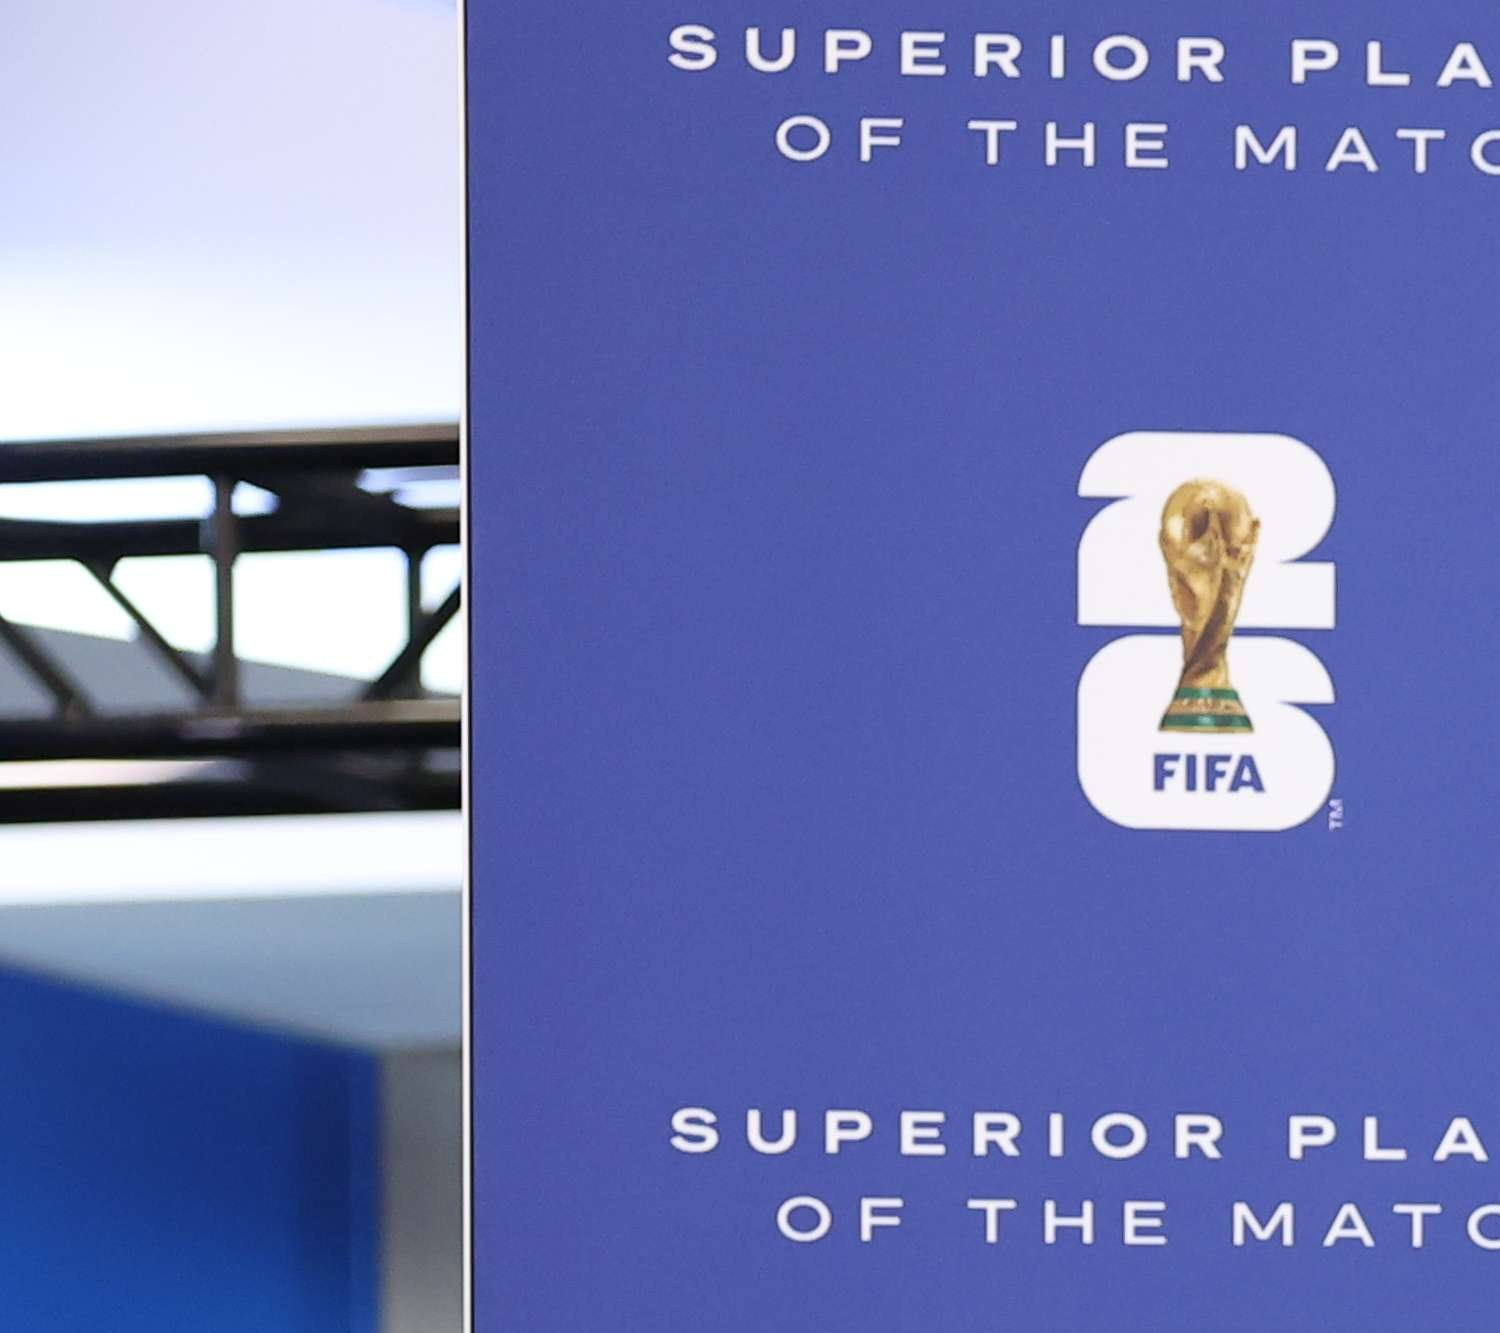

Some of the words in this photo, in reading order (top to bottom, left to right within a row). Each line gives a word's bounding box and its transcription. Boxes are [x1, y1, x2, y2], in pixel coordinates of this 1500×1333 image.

[667, 24, 1225, 82] SUPERIOR
[775, 115, 903, 162] OF
[967, 120, 1169, 168] THE
[1153, 752, 1266, 793] FIFA
[670, 1107, 1223, 1159] SUPERIOR
[776, 1196, 904, 1242] OF
[967, 1199, 1168, 1245] THE
